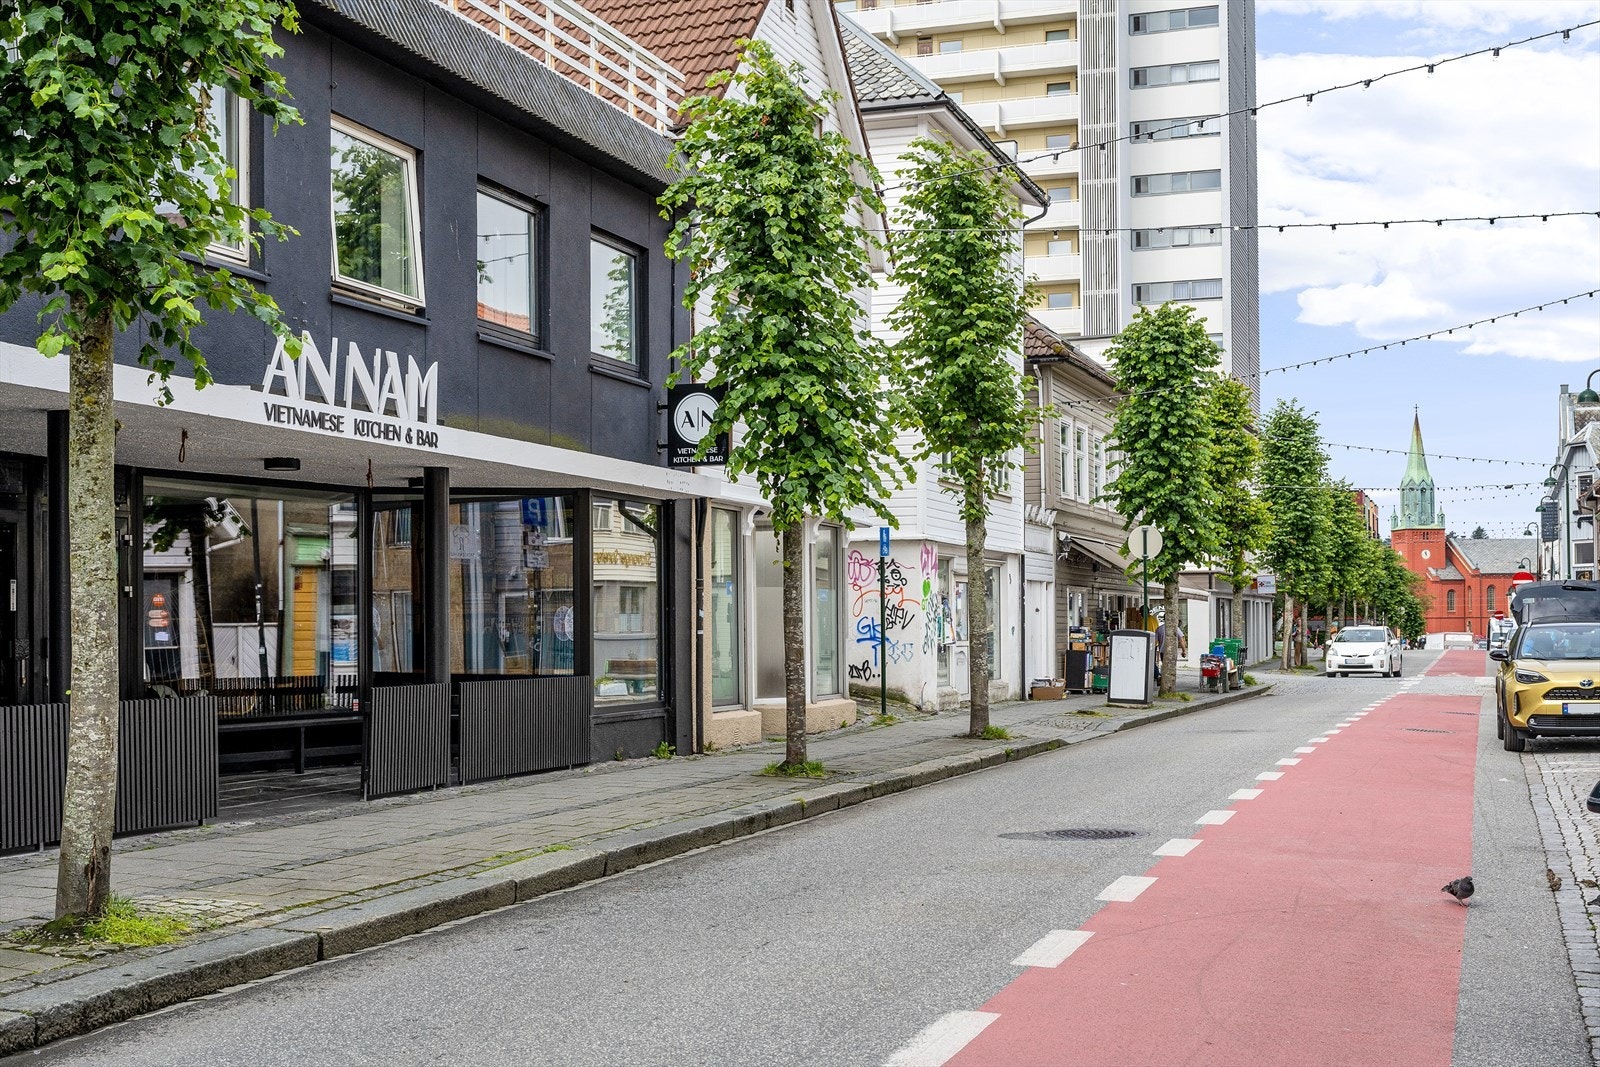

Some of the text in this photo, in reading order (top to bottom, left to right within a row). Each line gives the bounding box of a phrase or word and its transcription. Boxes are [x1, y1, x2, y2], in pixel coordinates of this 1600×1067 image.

[264, 402, 438, 448] VIETNAMESE KITCHEN & BAR
[677, 446, 718, 455] VIETNESE
[709, 455, 724, 463] BAR
